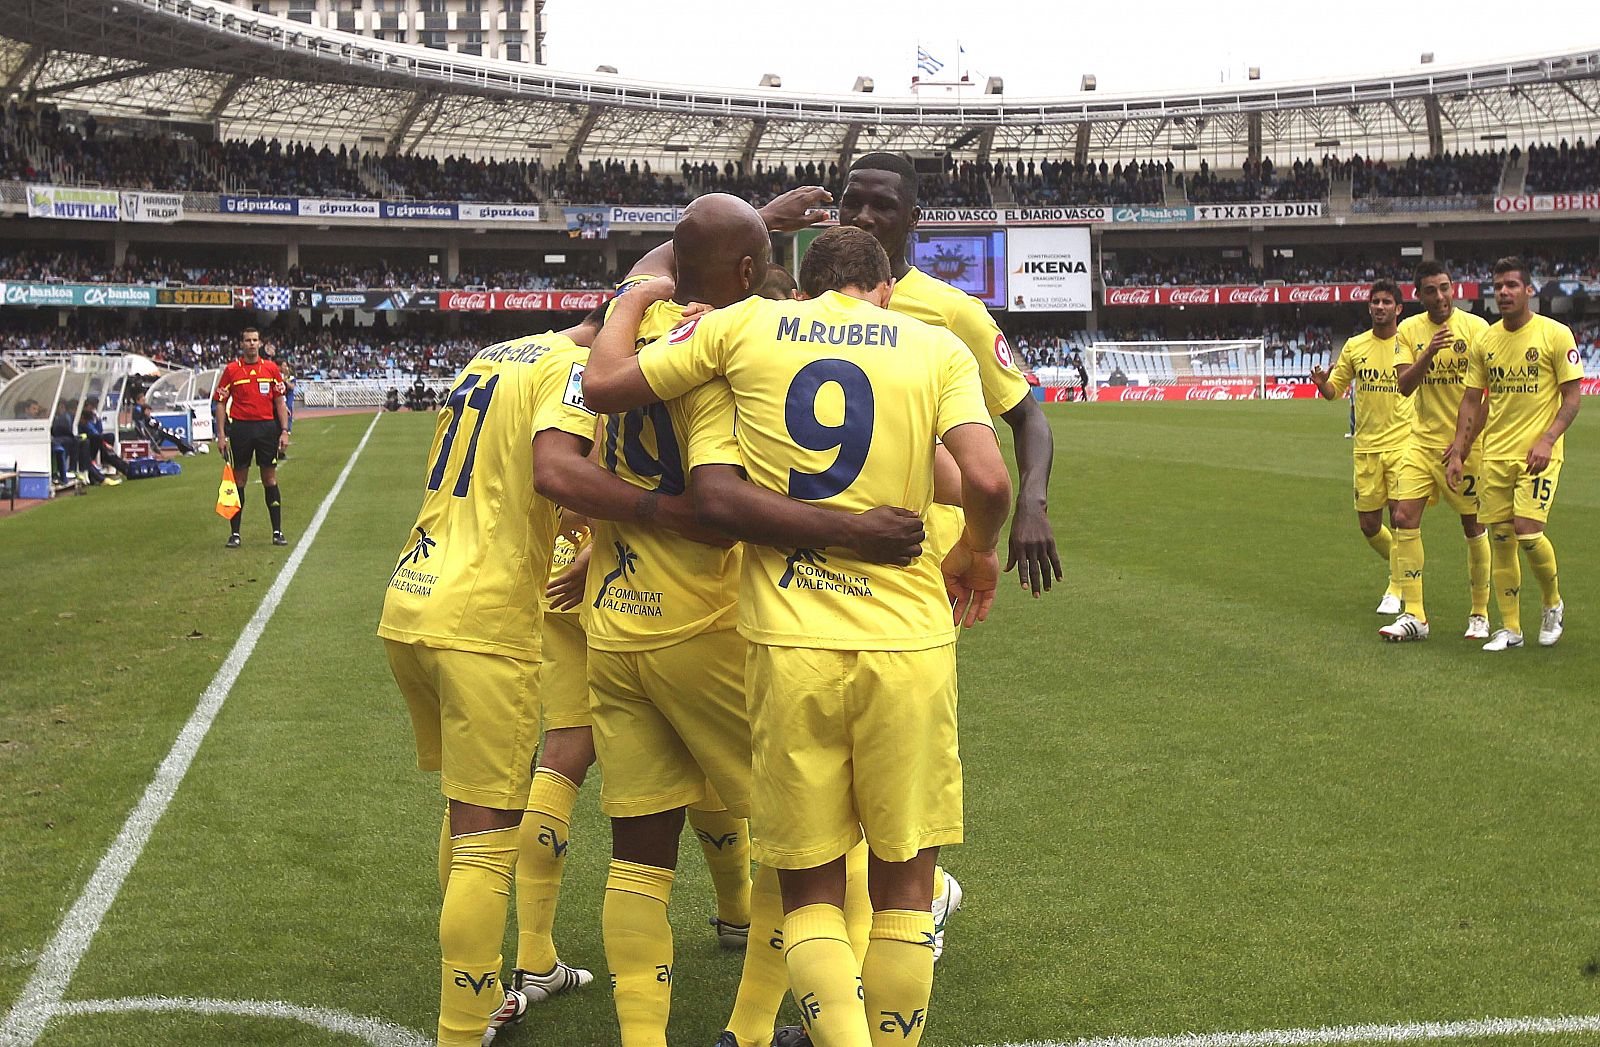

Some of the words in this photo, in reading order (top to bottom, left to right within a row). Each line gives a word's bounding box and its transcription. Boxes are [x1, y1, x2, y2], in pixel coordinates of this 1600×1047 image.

[237, 200, 291, 212] gipuzkoa
[319, 203, 375, 214] gipuzkoa
[1496, 196, 1534, 213] OGI
[1553, 193, 1600, 210] BER
[54, 203, 117, 219] MUTILAK
[396, 204, 452, 216] gipuzkoa
[479, 207, 535, 218] gipuzkoa
[957, 210, 998, 221] VASCO
[1005, 210, 1019, 220] EL
[1021, 209, 1063, 220] DIARIO
[1065, 208, 1105, 219] VASCO
[1141, 208, 1188, 218] bankoa
[1213, 203, 1319, 219] TXAPELDUN
[1024, 261, 1088, 274] IKENA
[29, 286, 73, 298] bankoa
[108, 287, 150, 300] bankoa
[776, 316, 898, 348] M.RUBEN
[1506, 366, 1538, 378] 人人网
[572, 395, 585, 406] LF
[428, 373, 499, 498] 11
[785, 358, 875, 501] 9
[1463, 474, 1480, 497] 2
[1531, 477, 1552, 501] 15
[398, 567, 439, 585] COMUNITAT
[608, 586, 664, 604] COMUNITAT
[796, 577, 873, 597] VALENCIANA
[602, 598, 663, 617] VALENCIANA
